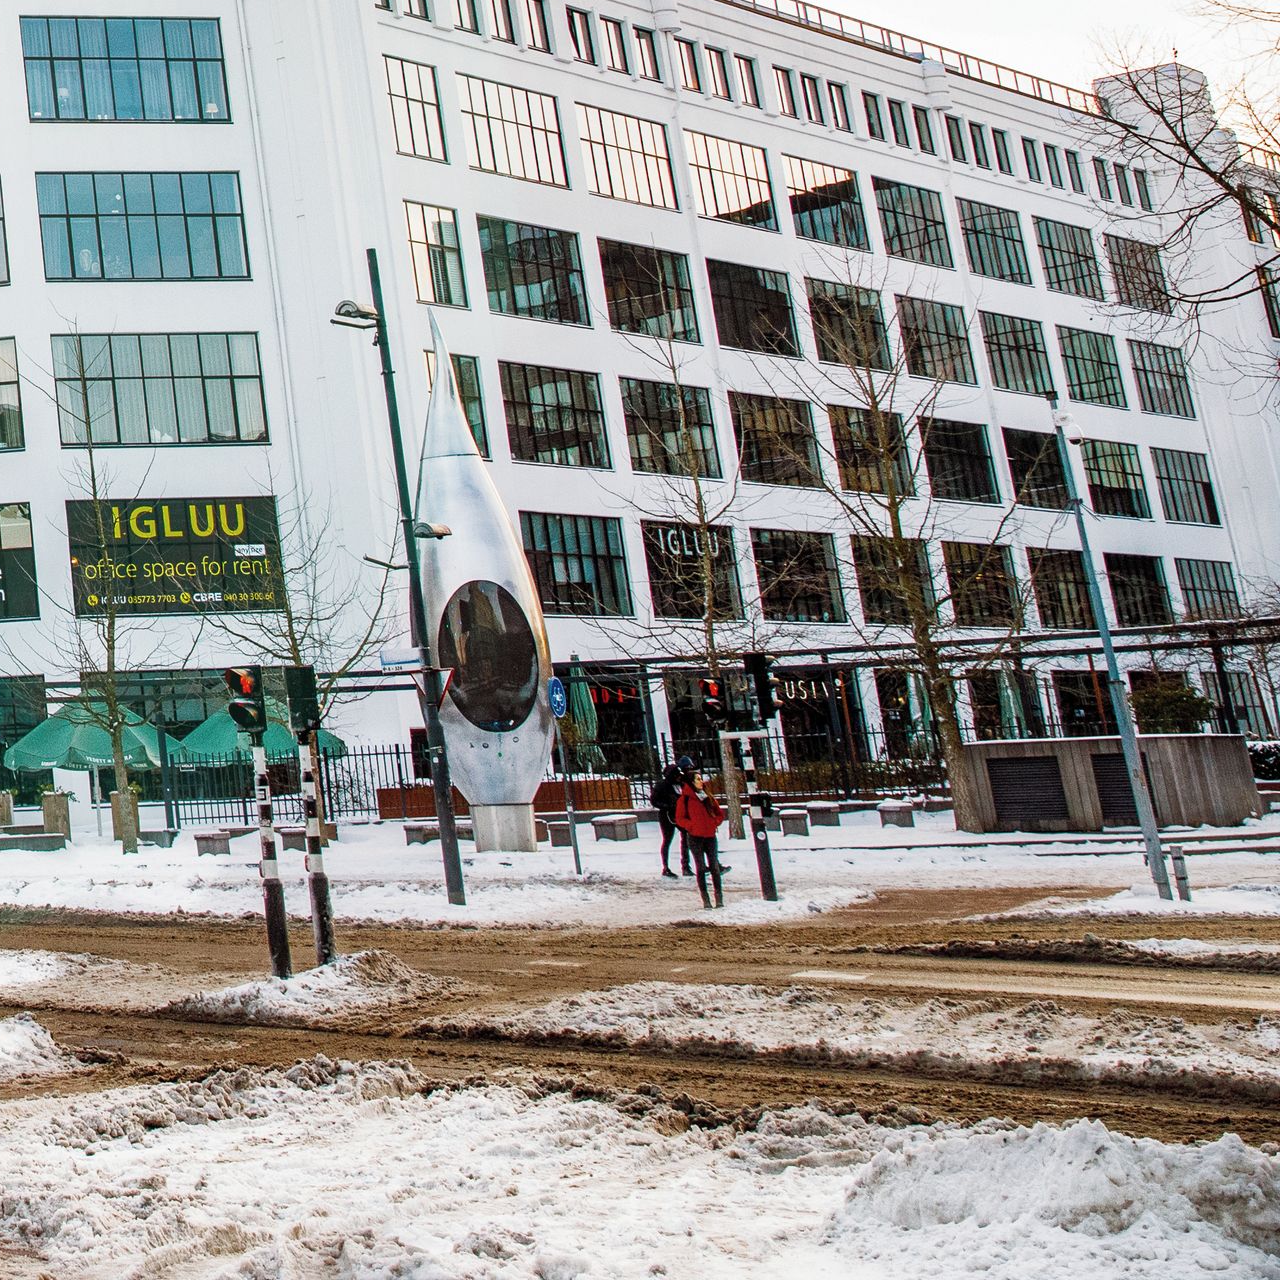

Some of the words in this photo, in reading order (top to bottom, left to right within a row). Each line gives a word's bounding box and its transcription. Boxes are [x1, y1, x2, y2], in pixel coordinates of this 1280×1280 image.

[111, 503, 245, 539] IGLUU
[658, 528, 719, 557] IGLUU
[143, 559, 197, 581] space
[200, 555, 228, 575] for
[232, 558, 271, 574] rent
[157, 594, 176, 603] 7703
[193, 592, 223, 602] CBRE
